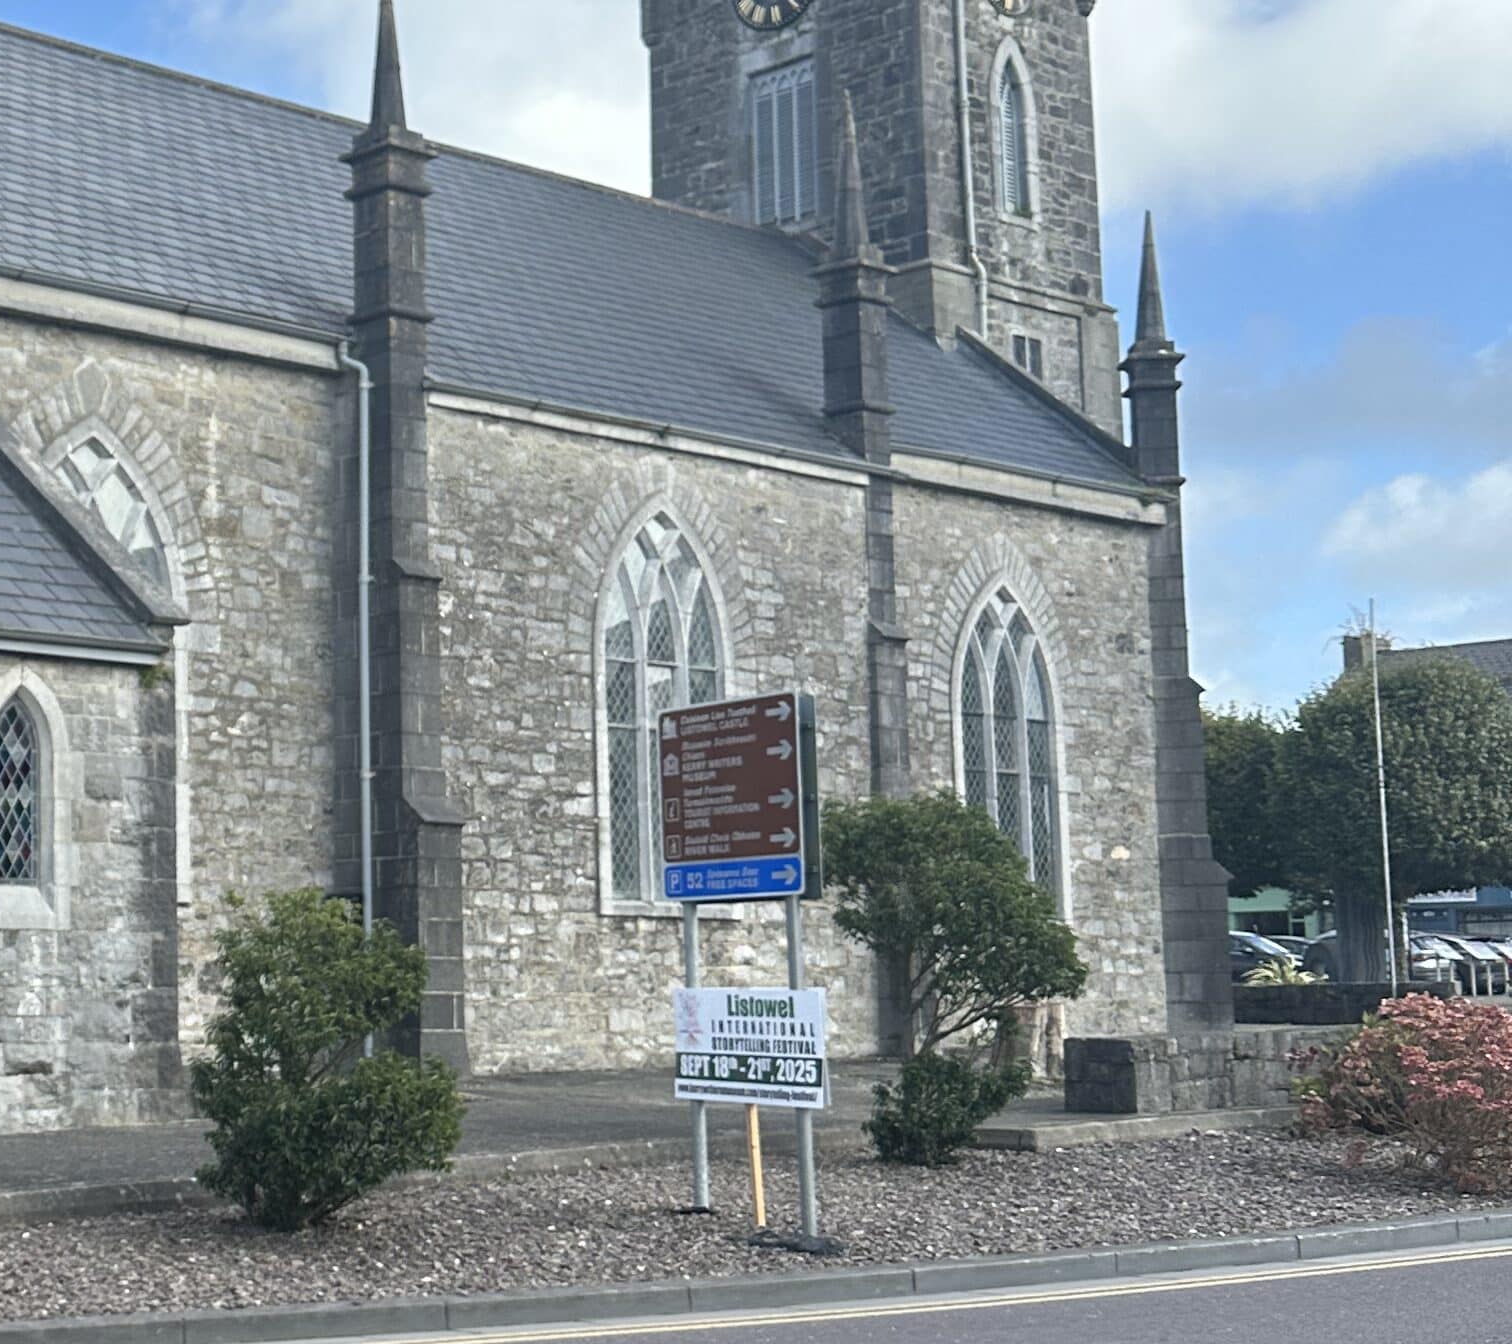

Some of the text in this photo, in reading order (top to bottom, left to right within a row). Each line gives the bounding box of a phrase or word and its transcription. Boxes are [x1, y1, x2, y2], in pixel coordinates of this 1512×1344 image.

[727, 994, 796, 1018] Listowel
[711, 1019, 817, 1038] INTERNATIONAL
[711, 1037, 817, 1056] STORYTELLING FESTIVAL
[679, 1053, 710, 1077] SEPT
[775, 1058, 818, 1083] 2025
